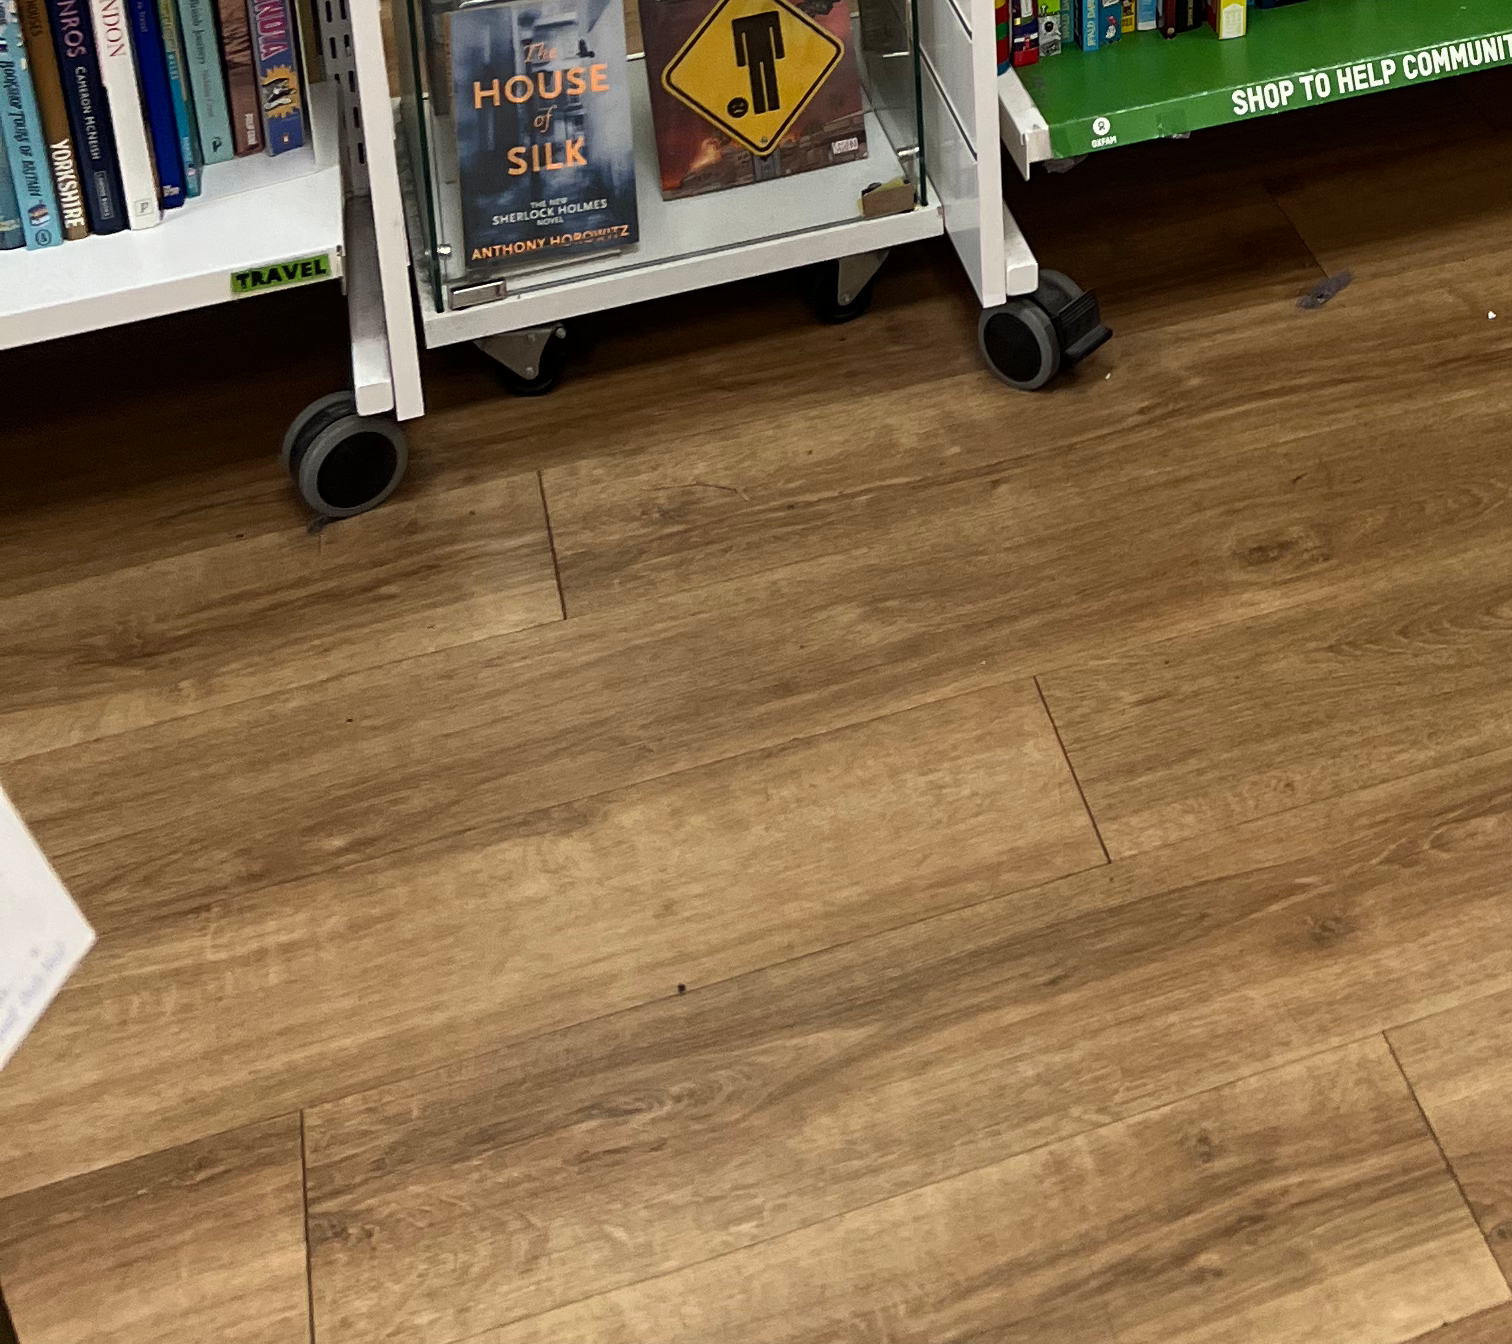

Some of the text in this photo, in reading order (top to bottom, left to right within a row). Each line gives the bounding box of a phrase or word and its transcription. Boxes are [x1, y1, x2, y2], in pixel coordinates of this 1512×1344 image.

[473, 63, 609, 109] HOUSE
[1232, 80, 1295, 115] SHOP
[1300, 73, 1331, 100] TO
[1337, 58, 1397, 95] HELP
[533, 105, 556, 133] of
[507, 137, 587, 176] SILK
[471, 224, 630, 260] ANTHONY HOROWITZ
[237, 258, 327, 290] TRAVEL
